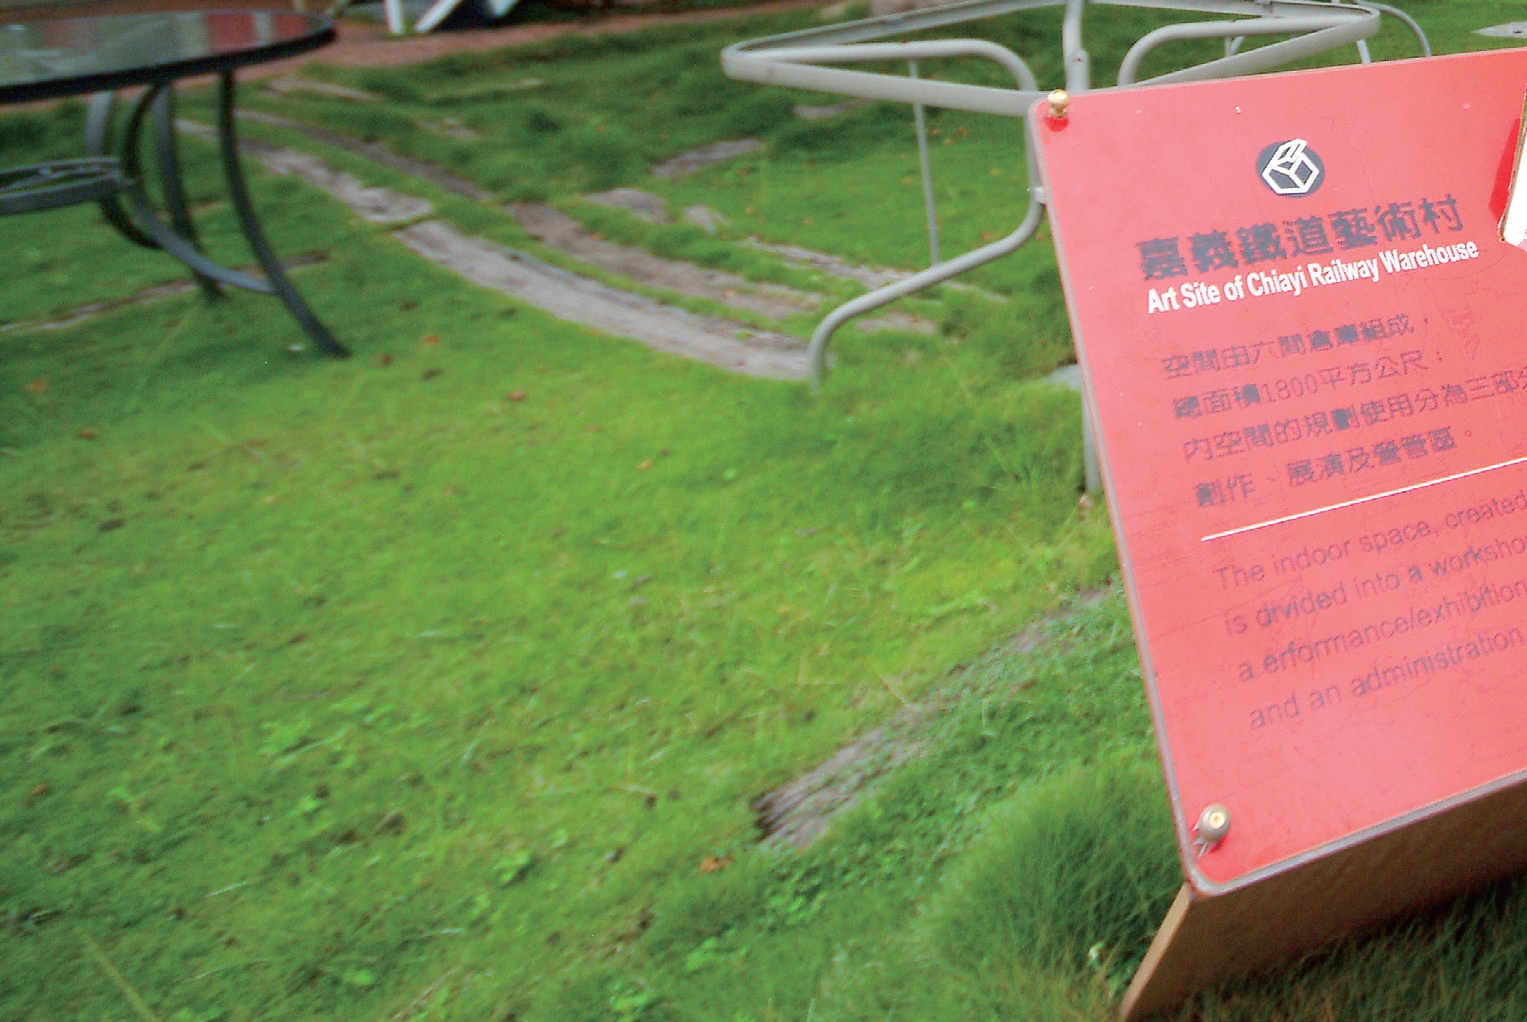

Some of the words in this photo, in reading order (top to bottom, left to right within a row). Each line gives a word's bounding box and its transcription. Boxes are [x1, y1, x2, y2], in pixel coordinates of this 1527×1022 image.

[1136, 194, 1465, 281] 嘉義鐵道藝術村
[1147, 287, 1178, 314] Art
[1182, 278, 1220, 308] Site
[1223, 277, 1245, 301] of
[1248, 263, 1307, 297] Chiayi
[1310, 257, 1380, 285] Railway
[1379, 238, 1480, 274] Warehouse
[1216, 561, 1266, 591] The
[1273, 539, 1351, 578] indoor
[1225, 613, 1249, 636] is
[1354, 572, 1401, 599] into
[1408, 564, 1423, 583] a
[1238, 662, 1254, 683] a
[1249, 692, 1300, 731] and
[1309, 685, 1342, 710] an
[1351, 626, 1524, 699] administration
